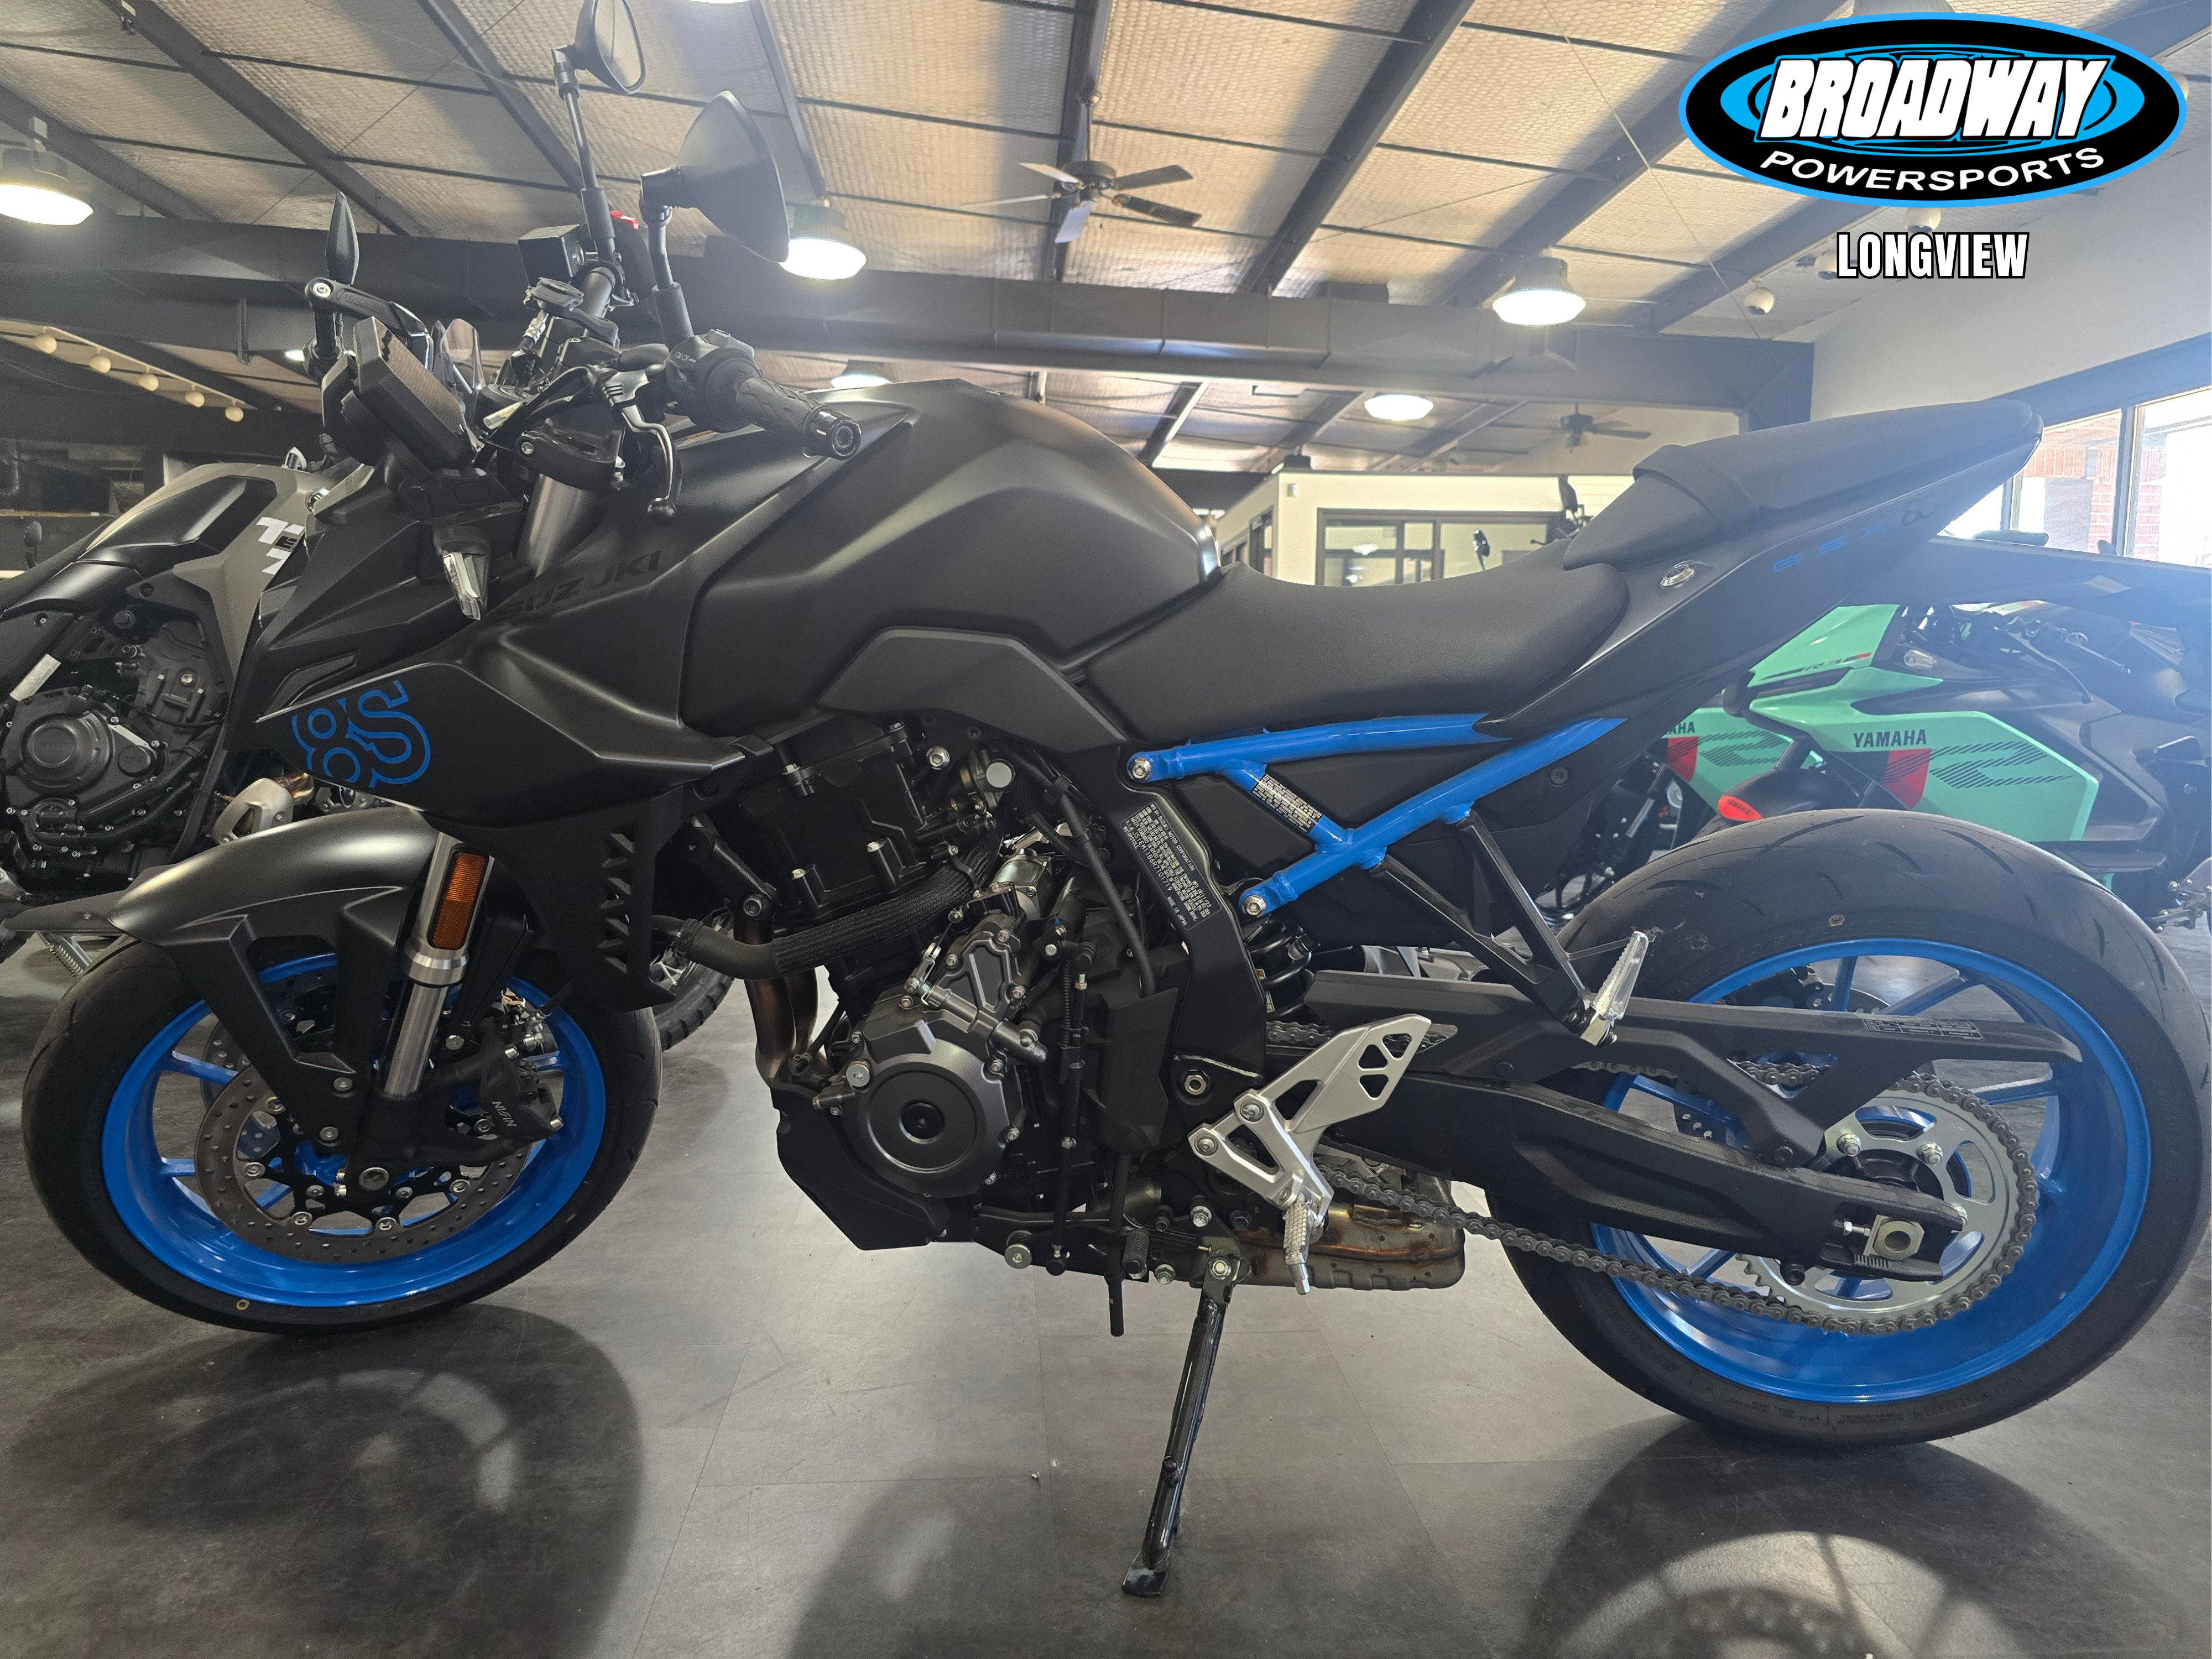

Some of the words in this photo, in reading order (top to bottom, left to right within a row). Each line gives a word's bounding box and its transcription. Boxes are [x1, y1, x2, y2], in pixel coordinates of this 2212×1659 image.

[1853, 729, 1927, 748] YAMAHA
[1725, 799, 1750, 815] YAMAHA
[1149, 847, 1159, 859] EFFECT
[1157, 815, 1169, 830] SUZUKI
[1167, 831, 1178, 844] MOTOR
[1176, 844, 1195, 871] CORPORATION
[1123, 826, 1139, 849] MOTORCYCLE
[1167, 896, 1175, 907] MADE
[1177, 912, 1187, 926] JAPAN
[1139, 822, 1149, 834] VEHICLE
[1173, 876, 1183, 889] FEDERAL
[1187, 898, 1197, 911] VEHICLE
[492, 1101, 517, 1126] NISSIN
